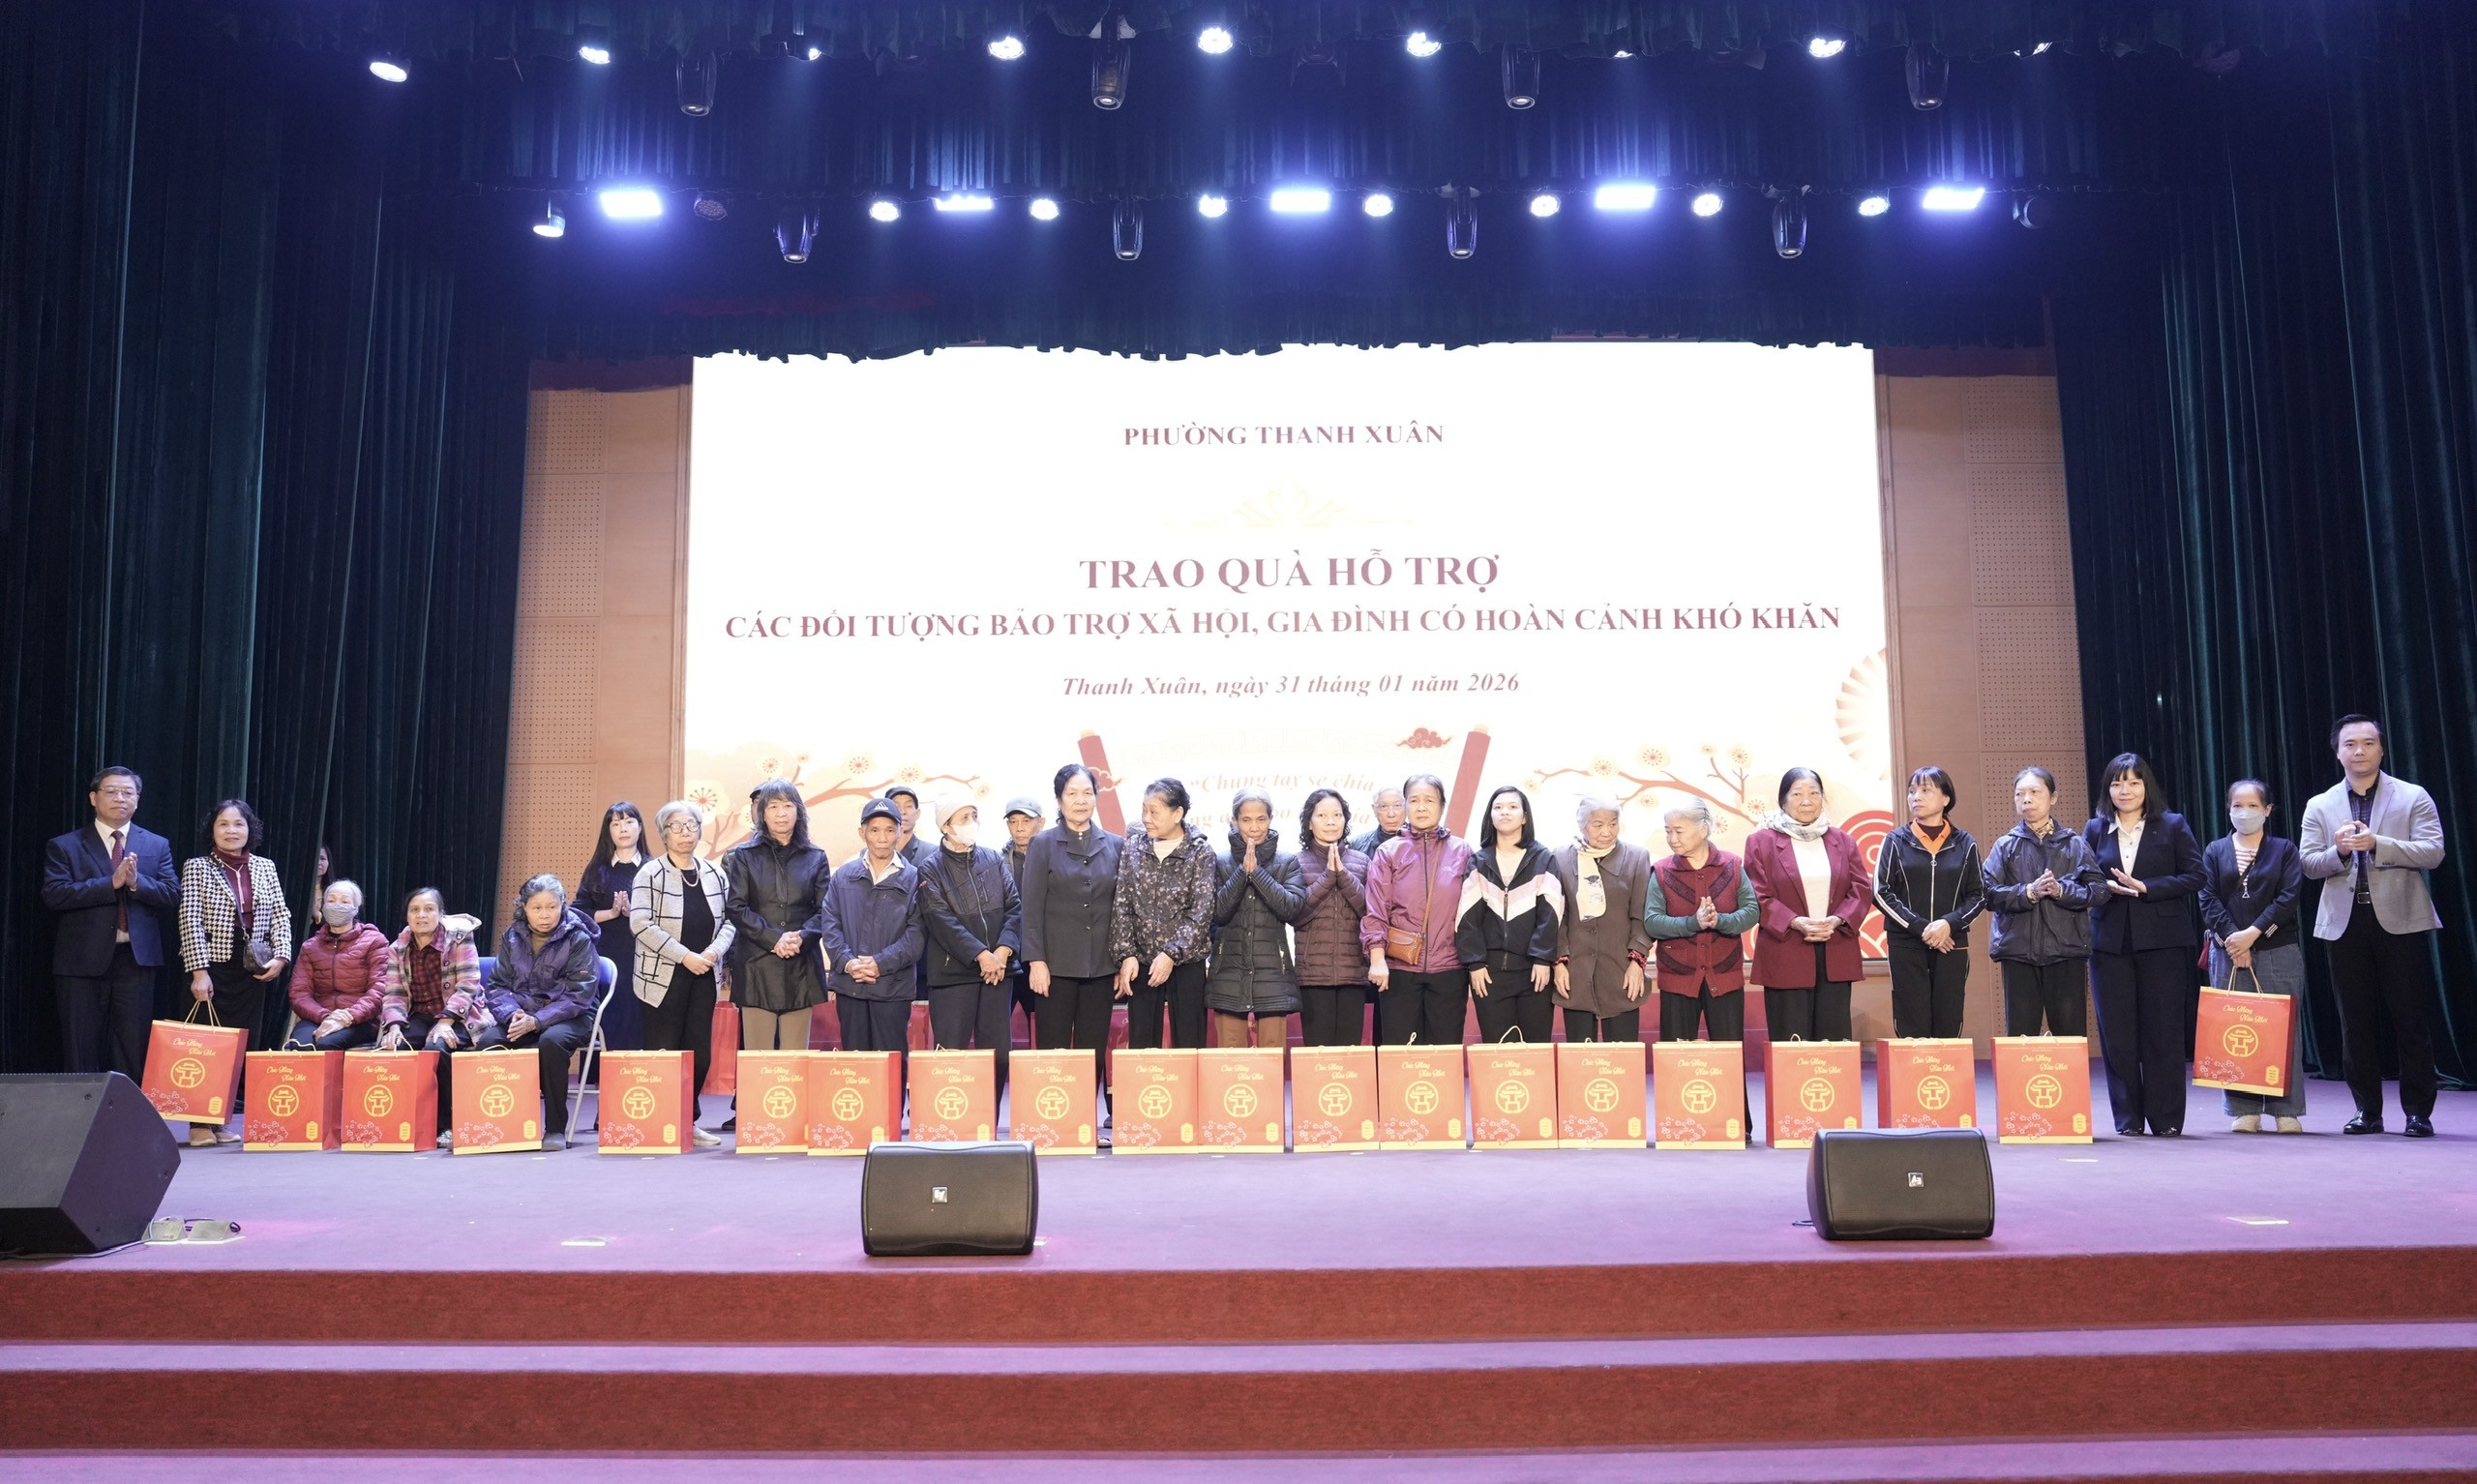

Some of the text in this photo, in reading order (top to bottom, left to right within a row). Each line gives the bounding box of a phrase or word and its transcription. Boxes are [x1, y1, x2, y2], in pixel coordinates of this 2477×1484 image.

[1124, 420, 1443, 445] PHƯỜNG THANH XUÂN
[1080, 549, 1500, 594] TRAO QUÀ HỖ TRỢ
[726, 602, 1839, 641] CÁC ĐỐI TƯỢNG BẢO TRỢ XÃ HỘI, GIA ĐÌNH CÓ HOÀN CẢNH KHÓ KHĂN
[1063, 673, 1518, 697] Thanh Xuân, ngày 31 tháng 01 năm 2026
[1274, 774, 1301, 789] tay
[1333, 774, 1374, 791] chia
